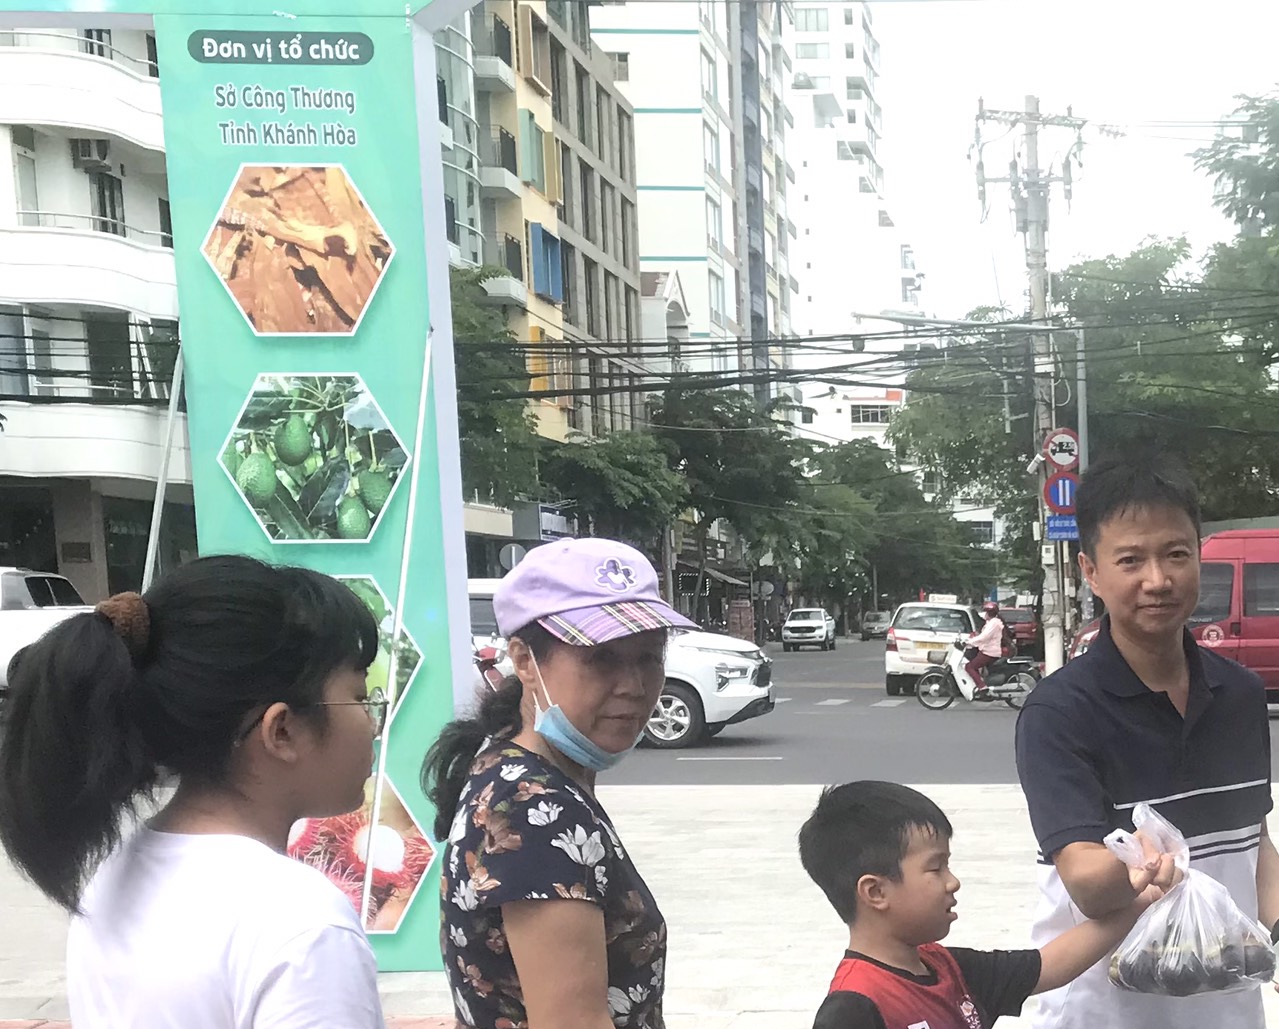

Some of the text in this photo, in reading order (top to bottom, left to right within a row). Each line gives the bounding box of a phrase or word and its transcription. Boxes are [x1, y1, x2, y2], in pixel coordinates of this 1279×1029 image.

[202, 33, 360, 62] Đơn vị tổ chức
[215, 84, 355, 114] Sở Công Thương
[263, 122, 317, 145] Khánh
[323, 123, 356, 145] Hòa
